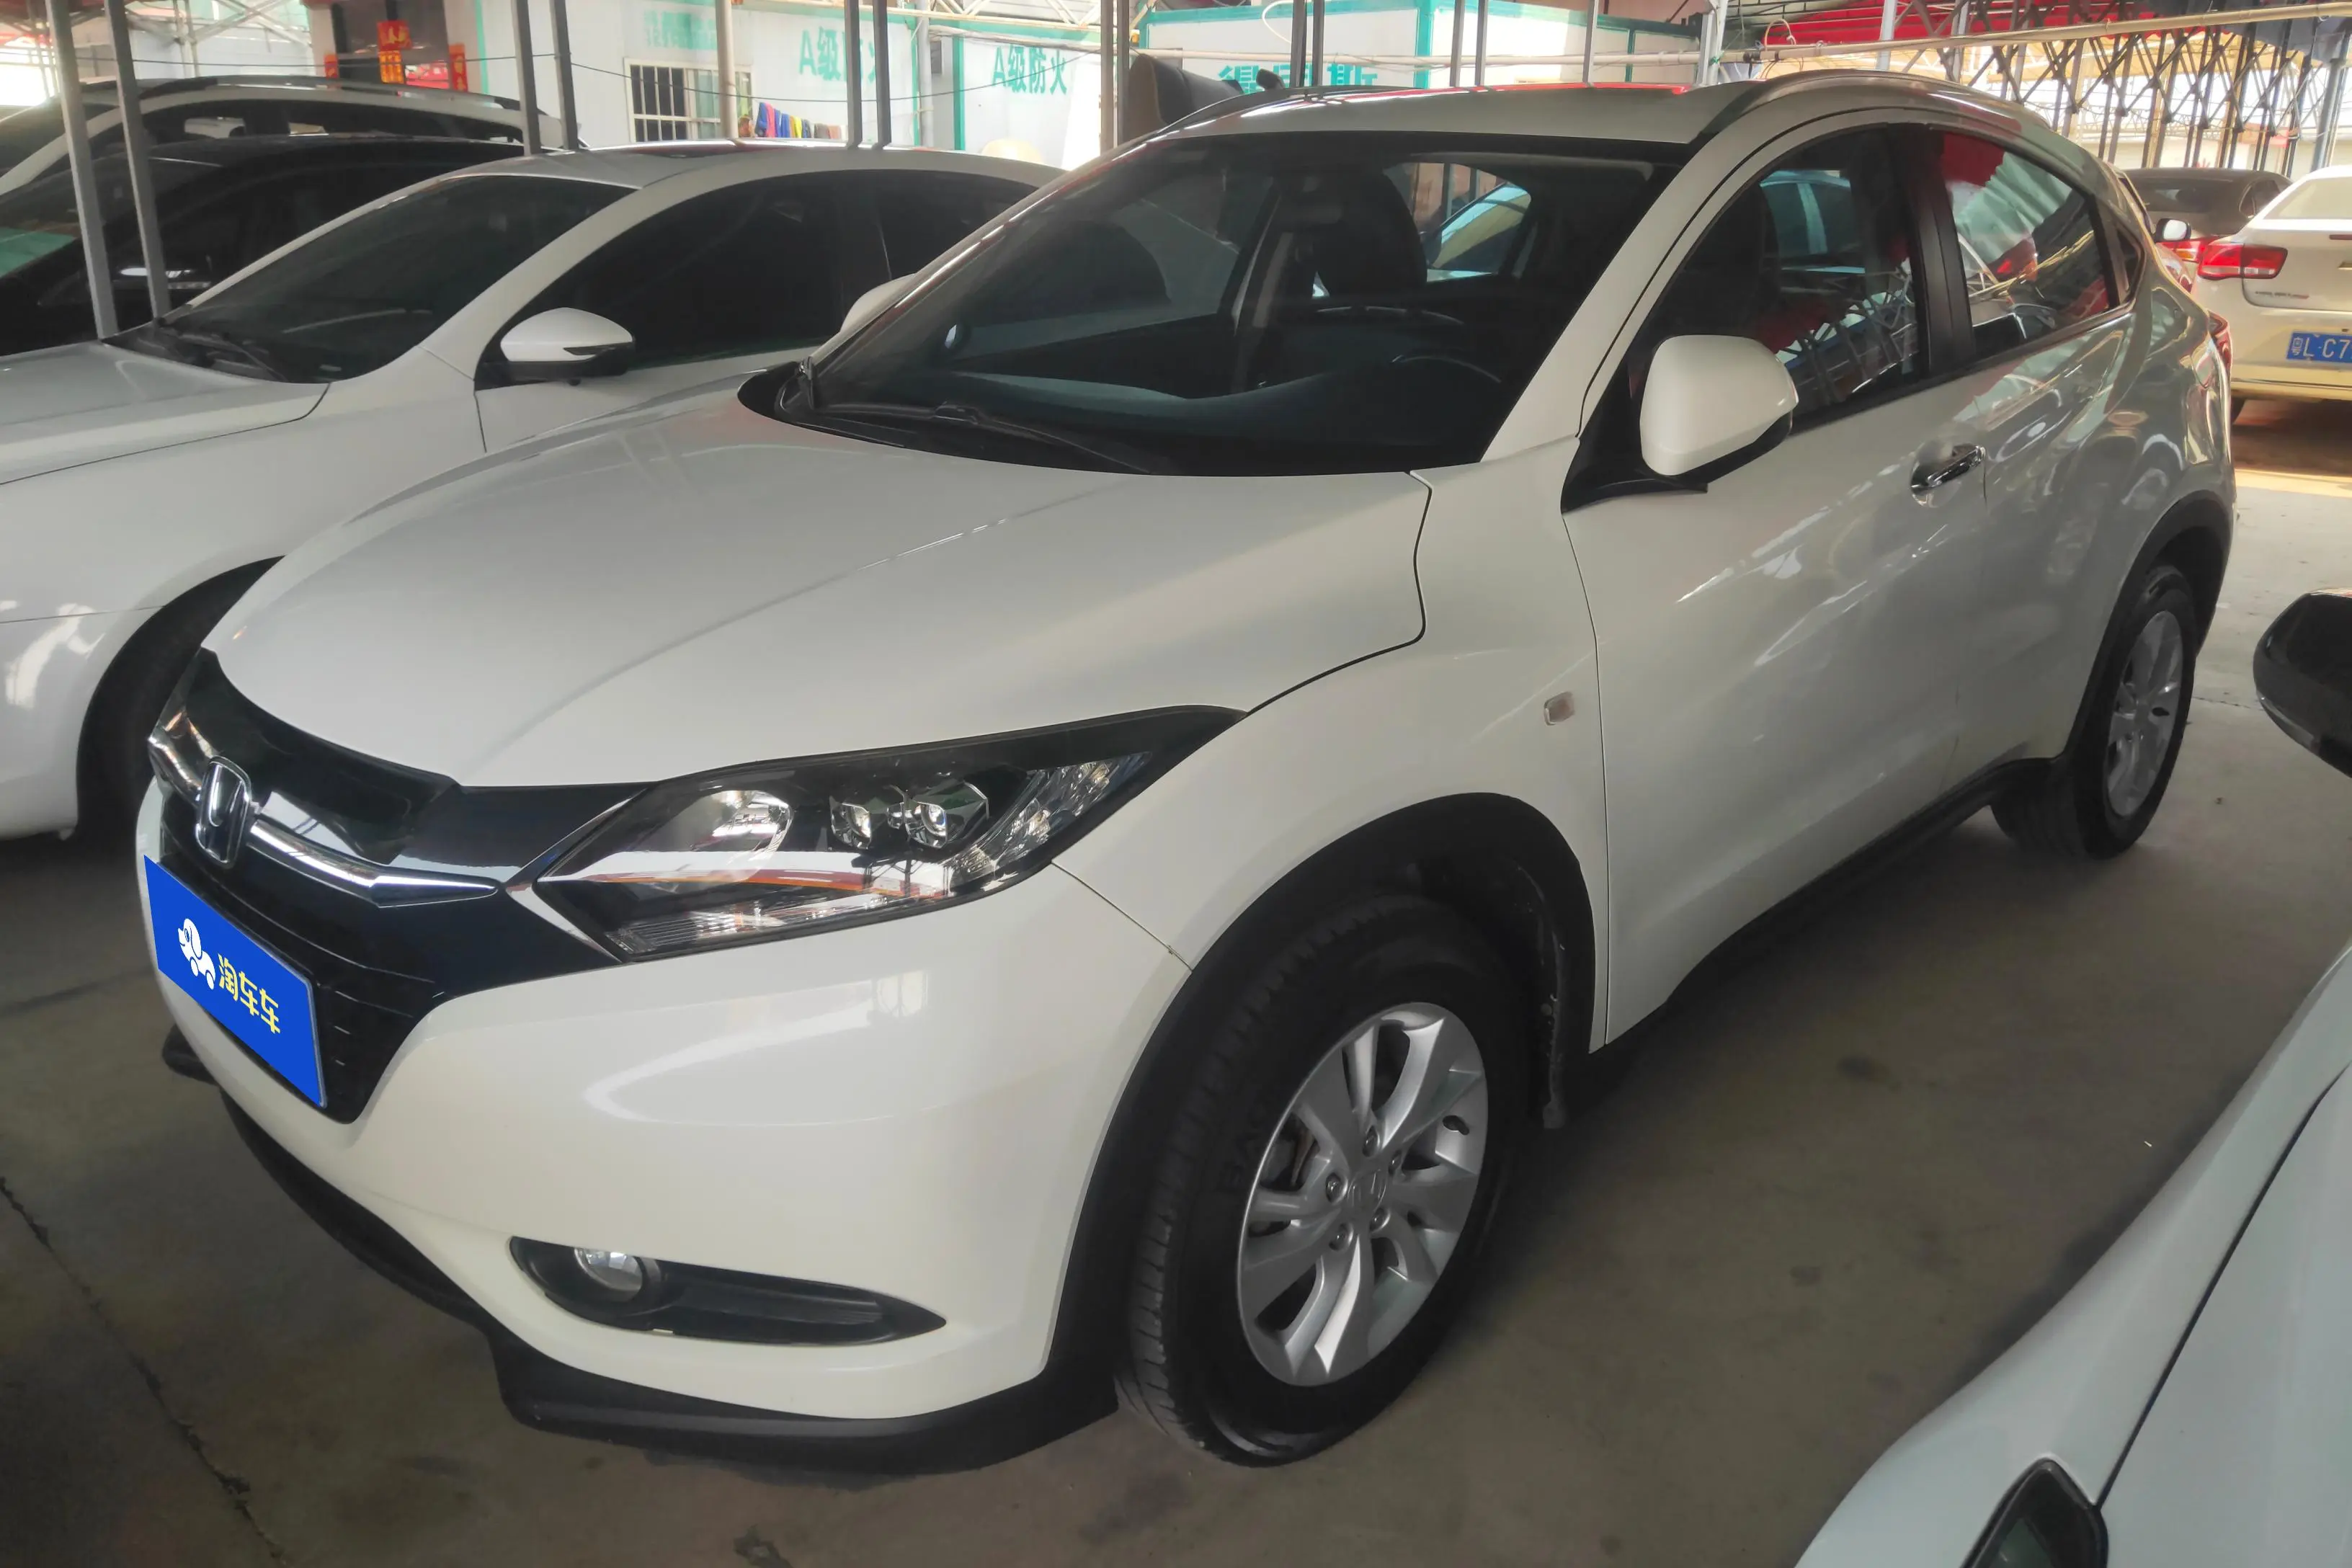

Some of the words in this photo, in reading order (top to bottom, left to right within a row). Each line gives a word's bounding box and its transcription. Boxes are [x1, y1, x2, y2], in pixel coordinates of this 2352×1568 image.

[799, 26, 876, 84] A级
[992, 45, 1067, 95] A级防火
